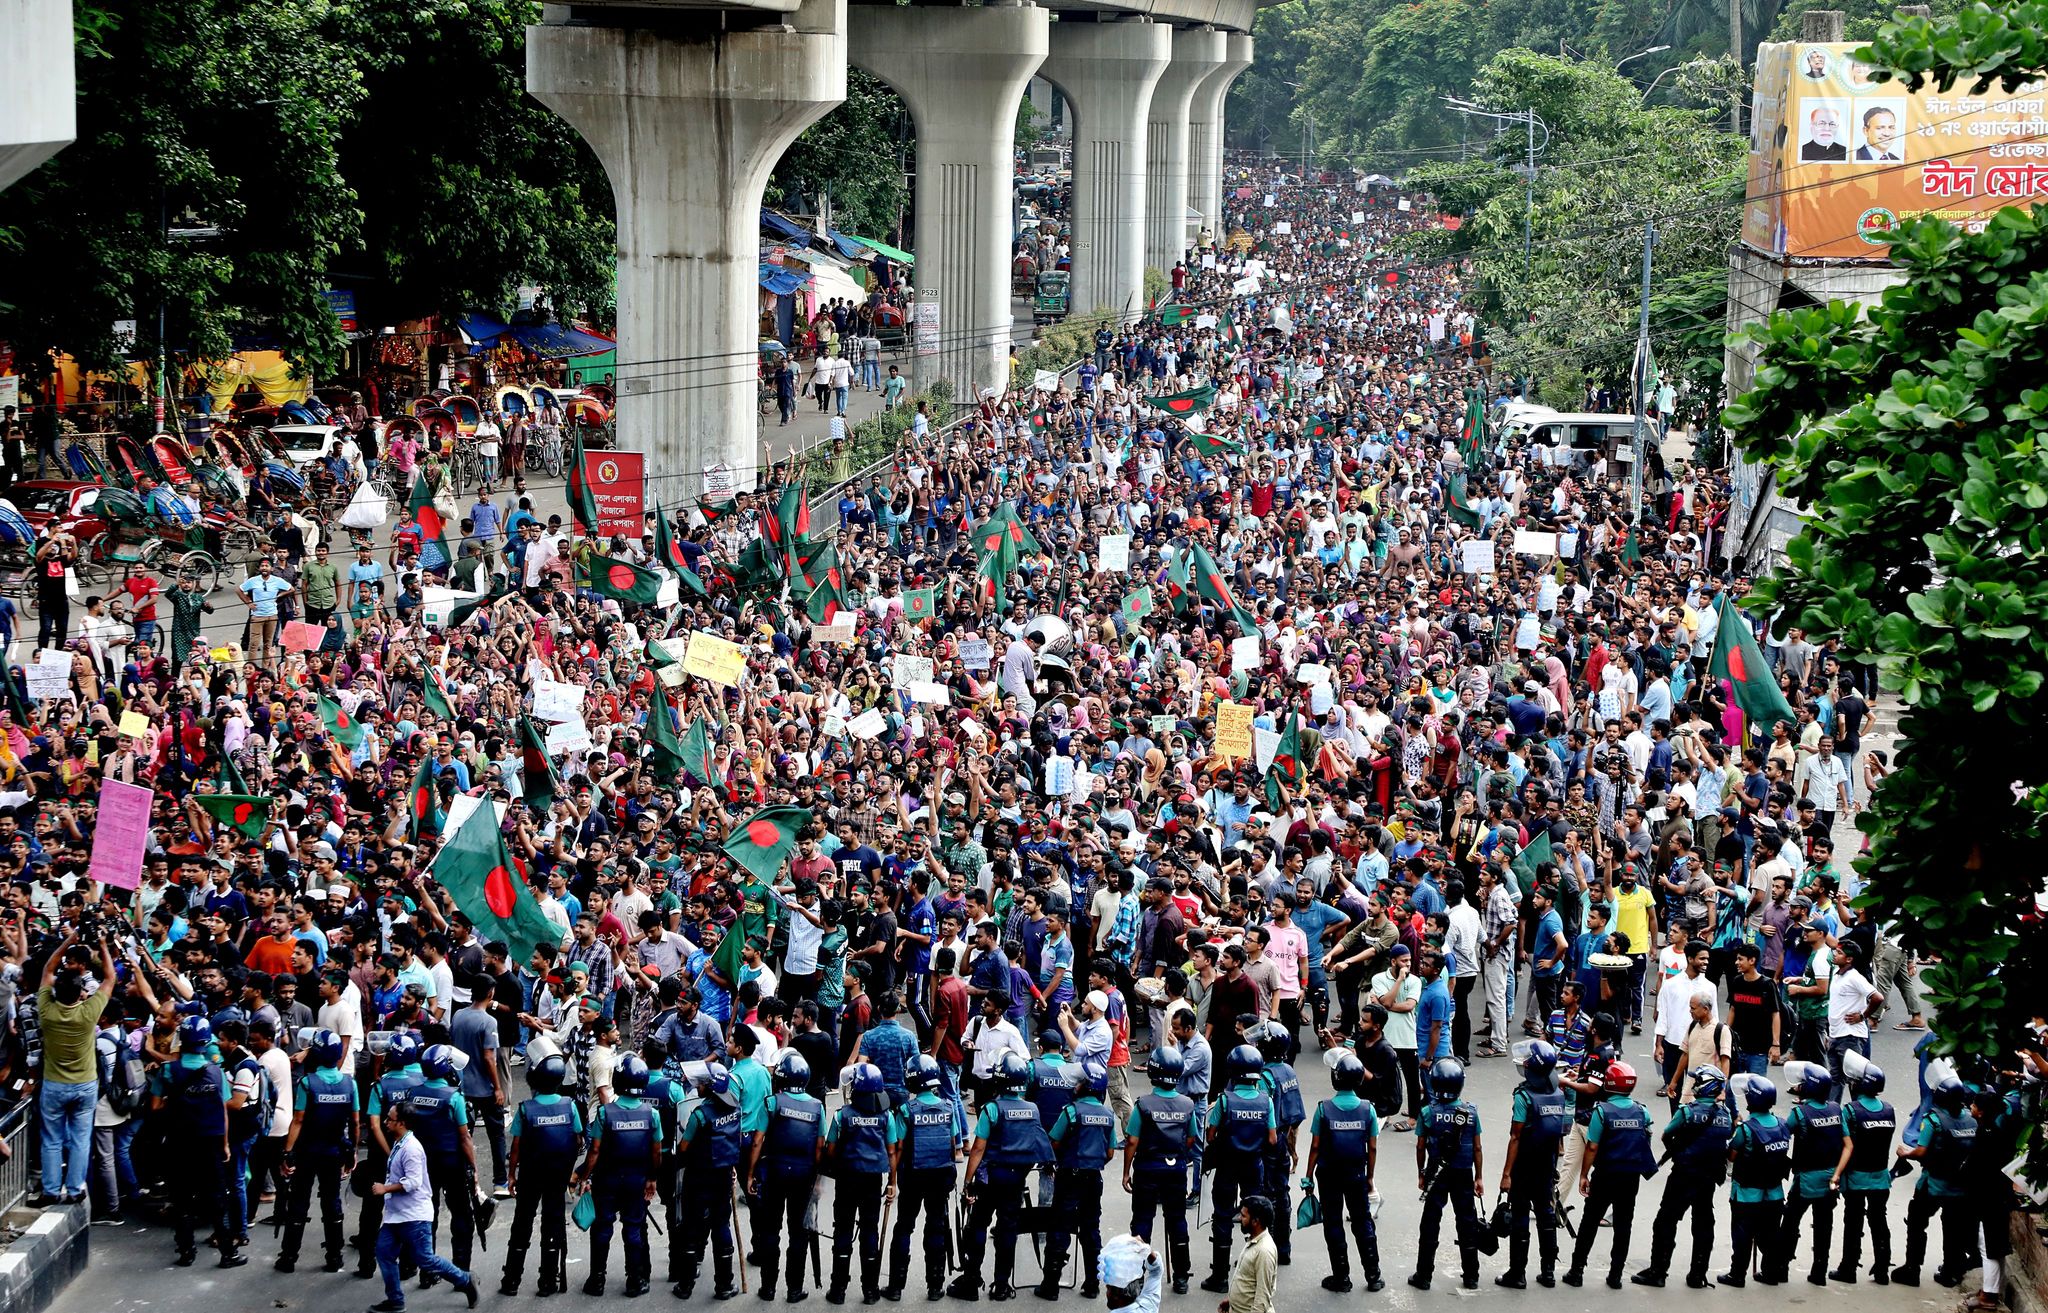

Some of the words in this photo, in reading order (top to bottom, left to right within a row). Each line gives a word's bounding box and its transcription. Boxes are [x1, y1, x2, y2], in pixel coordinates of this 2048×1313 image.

[1967, 116, 2048, 138] ওয়ার্ডবাসী
[1923, 160, 1977, 196] ঈদ
[415, 1097, 437, 1105] POLICE
[715, 1112, 739, 1127] POLICE
[786, 1109, 812, 1120] POLICE
[914, 1114, 950, 1124] POLICE
[1154, 1112, 1185, 1121] POLICE
[1237, 1110, 1262, 1119] POLICE
[1436, 1113, 1473, 1124] POLE
[540, 1116, 565, 1124] POLICE
[618, 1121, 643, 1129] POLICE
[1816, 1116, 1840, 1126] POLICE
[1869, 1120, 1893, 1128] POLICE
[1765, 1141, 1789, 1153] POLICE
